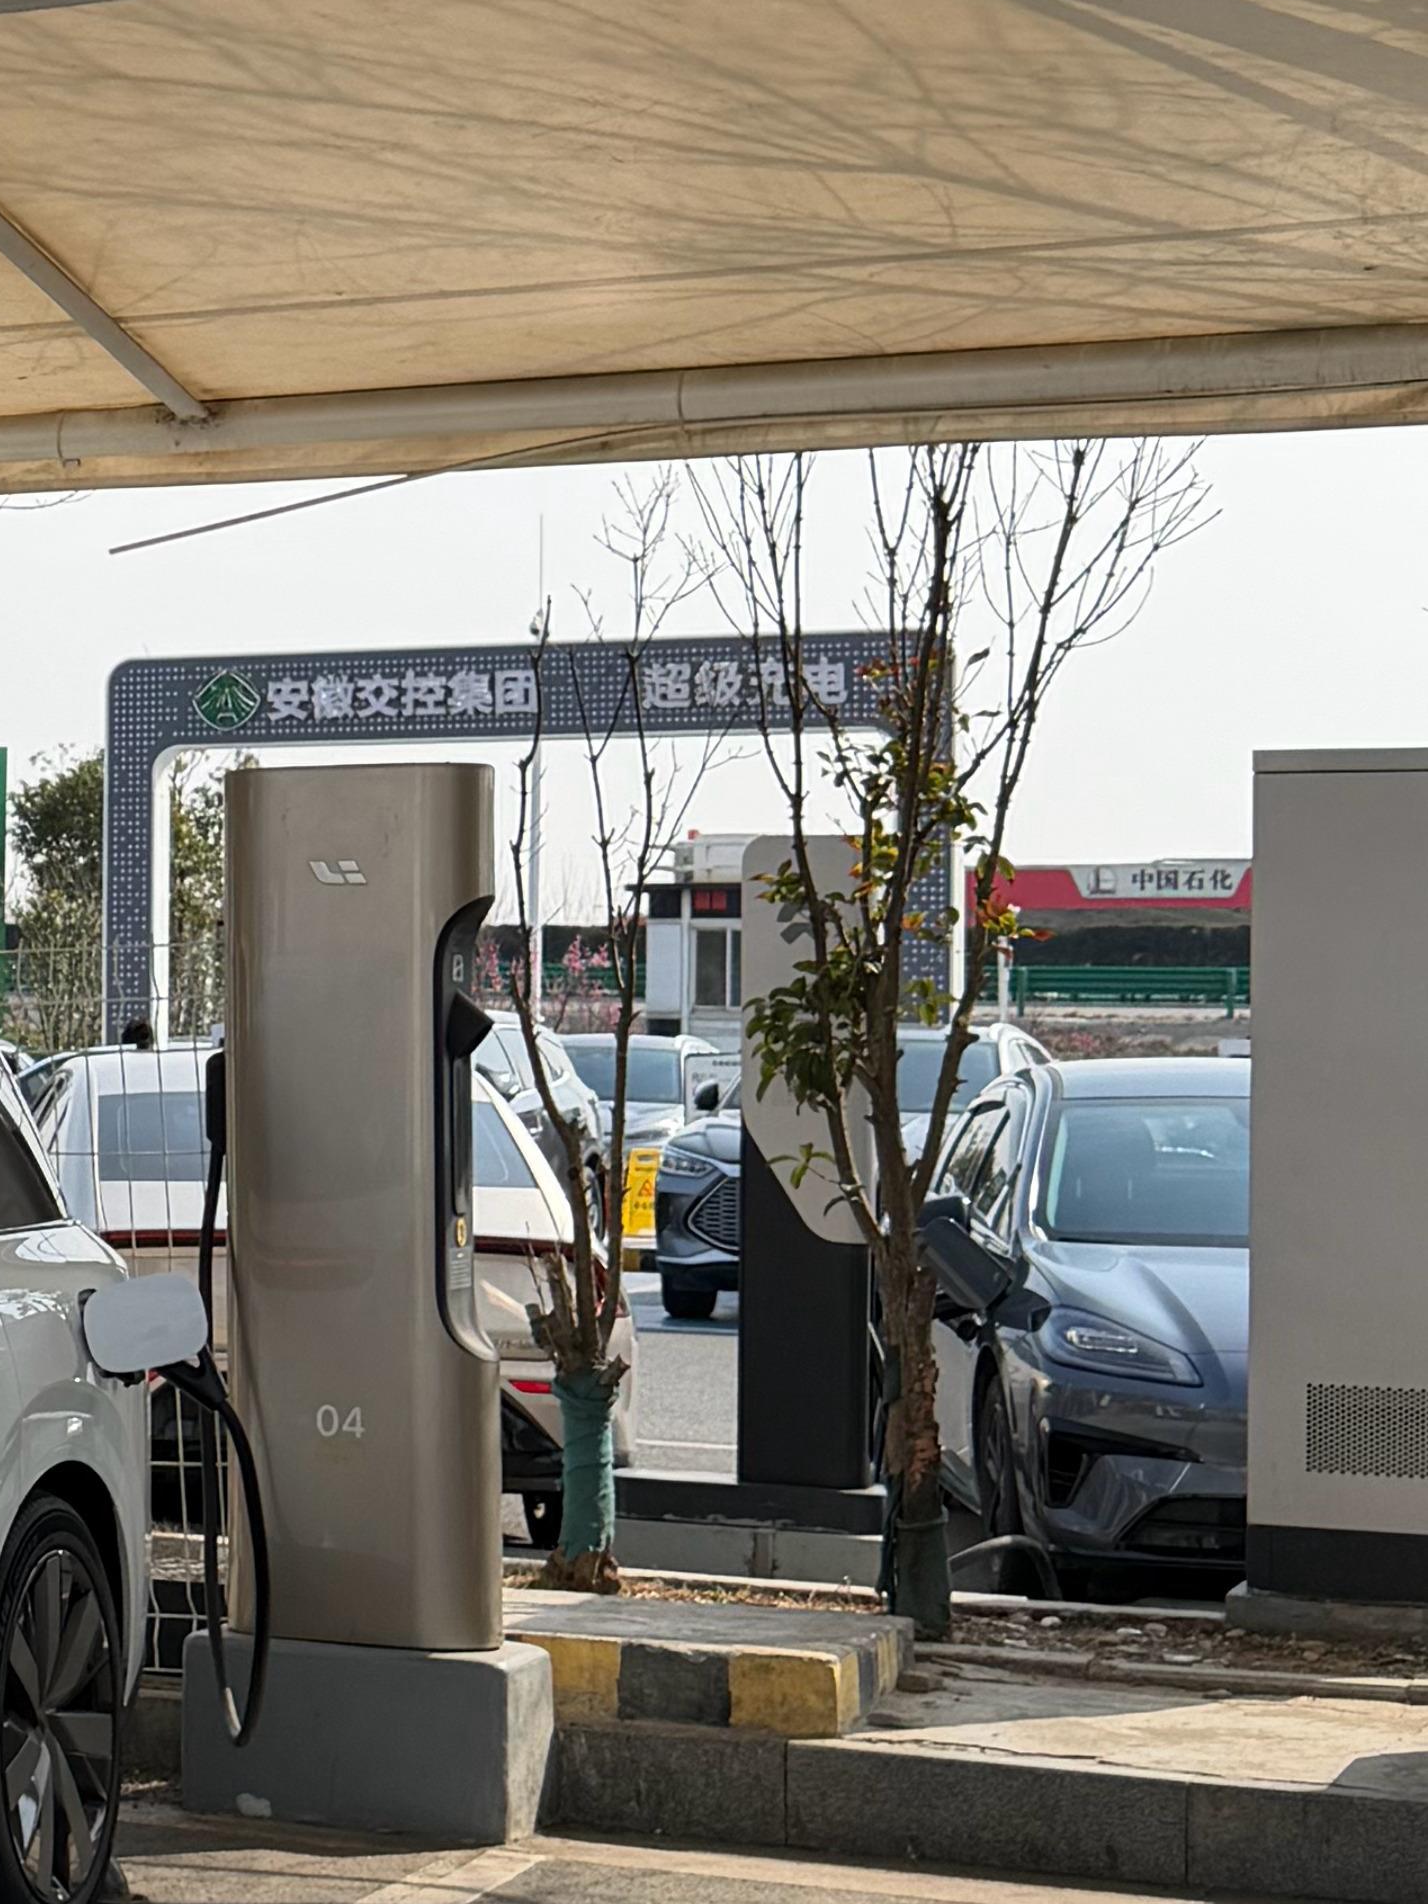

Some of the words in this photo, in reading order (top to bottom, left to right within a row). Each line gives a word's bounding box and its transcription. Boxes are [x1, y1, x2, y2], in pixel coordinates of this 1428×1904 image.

[267, 669, 539, 722] 安徽交控集团
[642, 656, 848, 709] 超级充电
[1132, 868, 1233, 891] 中国石化
[316, 1404, 366, 1438] 04
